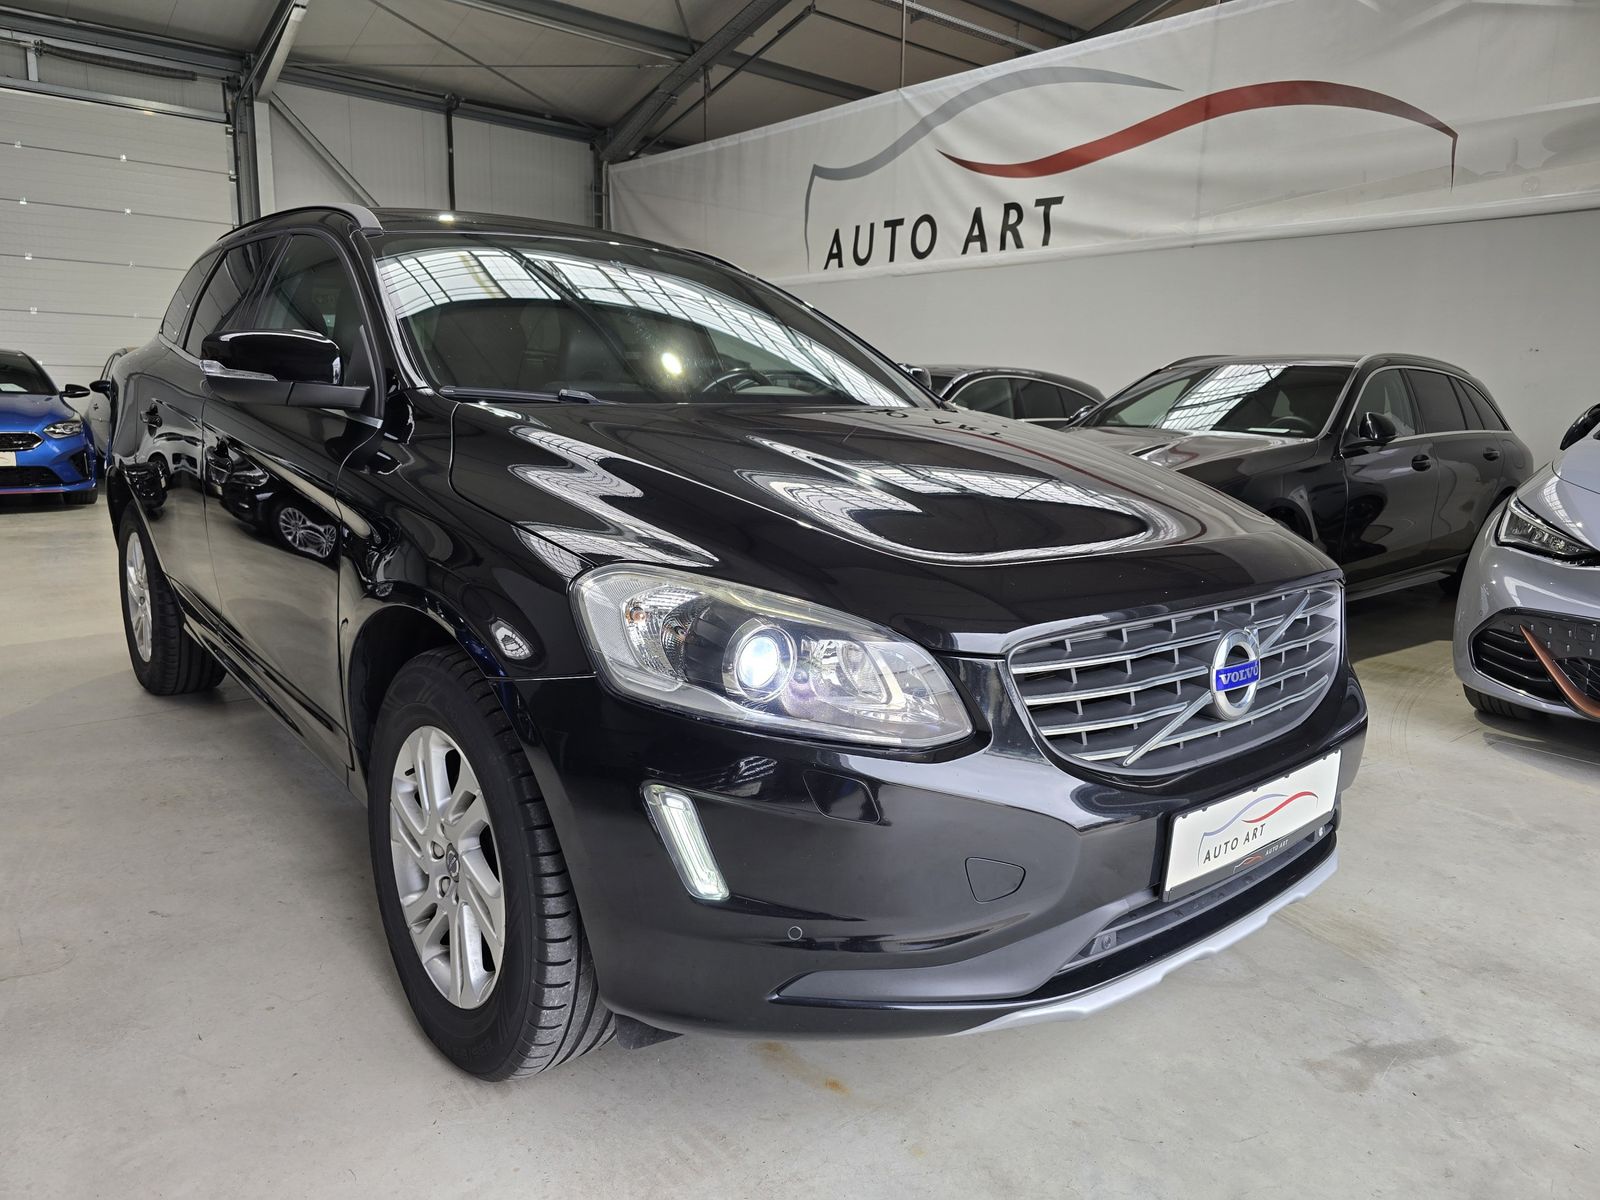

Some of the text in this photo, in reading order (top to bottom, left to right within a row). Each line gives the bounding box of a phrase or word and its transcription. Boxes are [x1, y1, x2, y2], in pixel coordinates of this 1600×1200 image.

[823, 195, 1065, 270] AUTO ART
[1218, 665, 1259, 685] VOLVO
[1203, 823, 1266, 864] AUTO ART
[1265, 839, 1289, 856] AUTO ART
